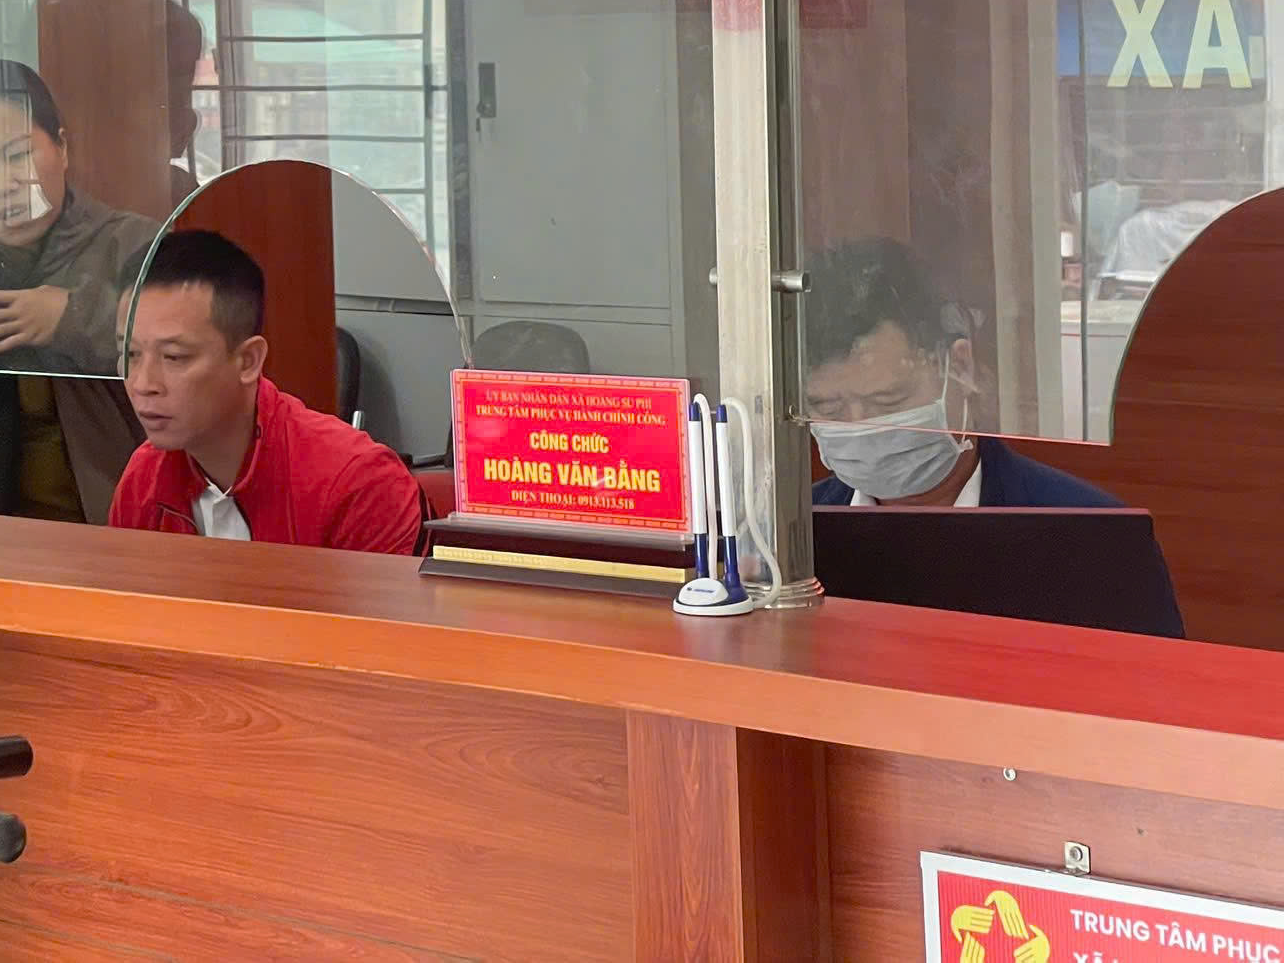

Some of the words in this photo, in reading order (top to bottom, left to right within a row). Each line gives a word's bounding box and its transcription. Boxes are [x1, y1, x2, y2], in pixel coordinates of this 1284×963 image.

[476, 405, 507, 417] TRUNG
[508, 405, 529, 419] TÂM
[531, 407, 557, 421] PHỤC
[529, 429, 568, 451] CÔNG
[572, 431, 609, 454] CHỨC
[483, 455, 552, 485] HOÀNG
[556, 460, 598, 487] VĂN
[603, 458, 661, 492] BẰNG
[1070, 909, 1150, 942] TRUNG
[1155, 921, 1207, 953] TÂM
